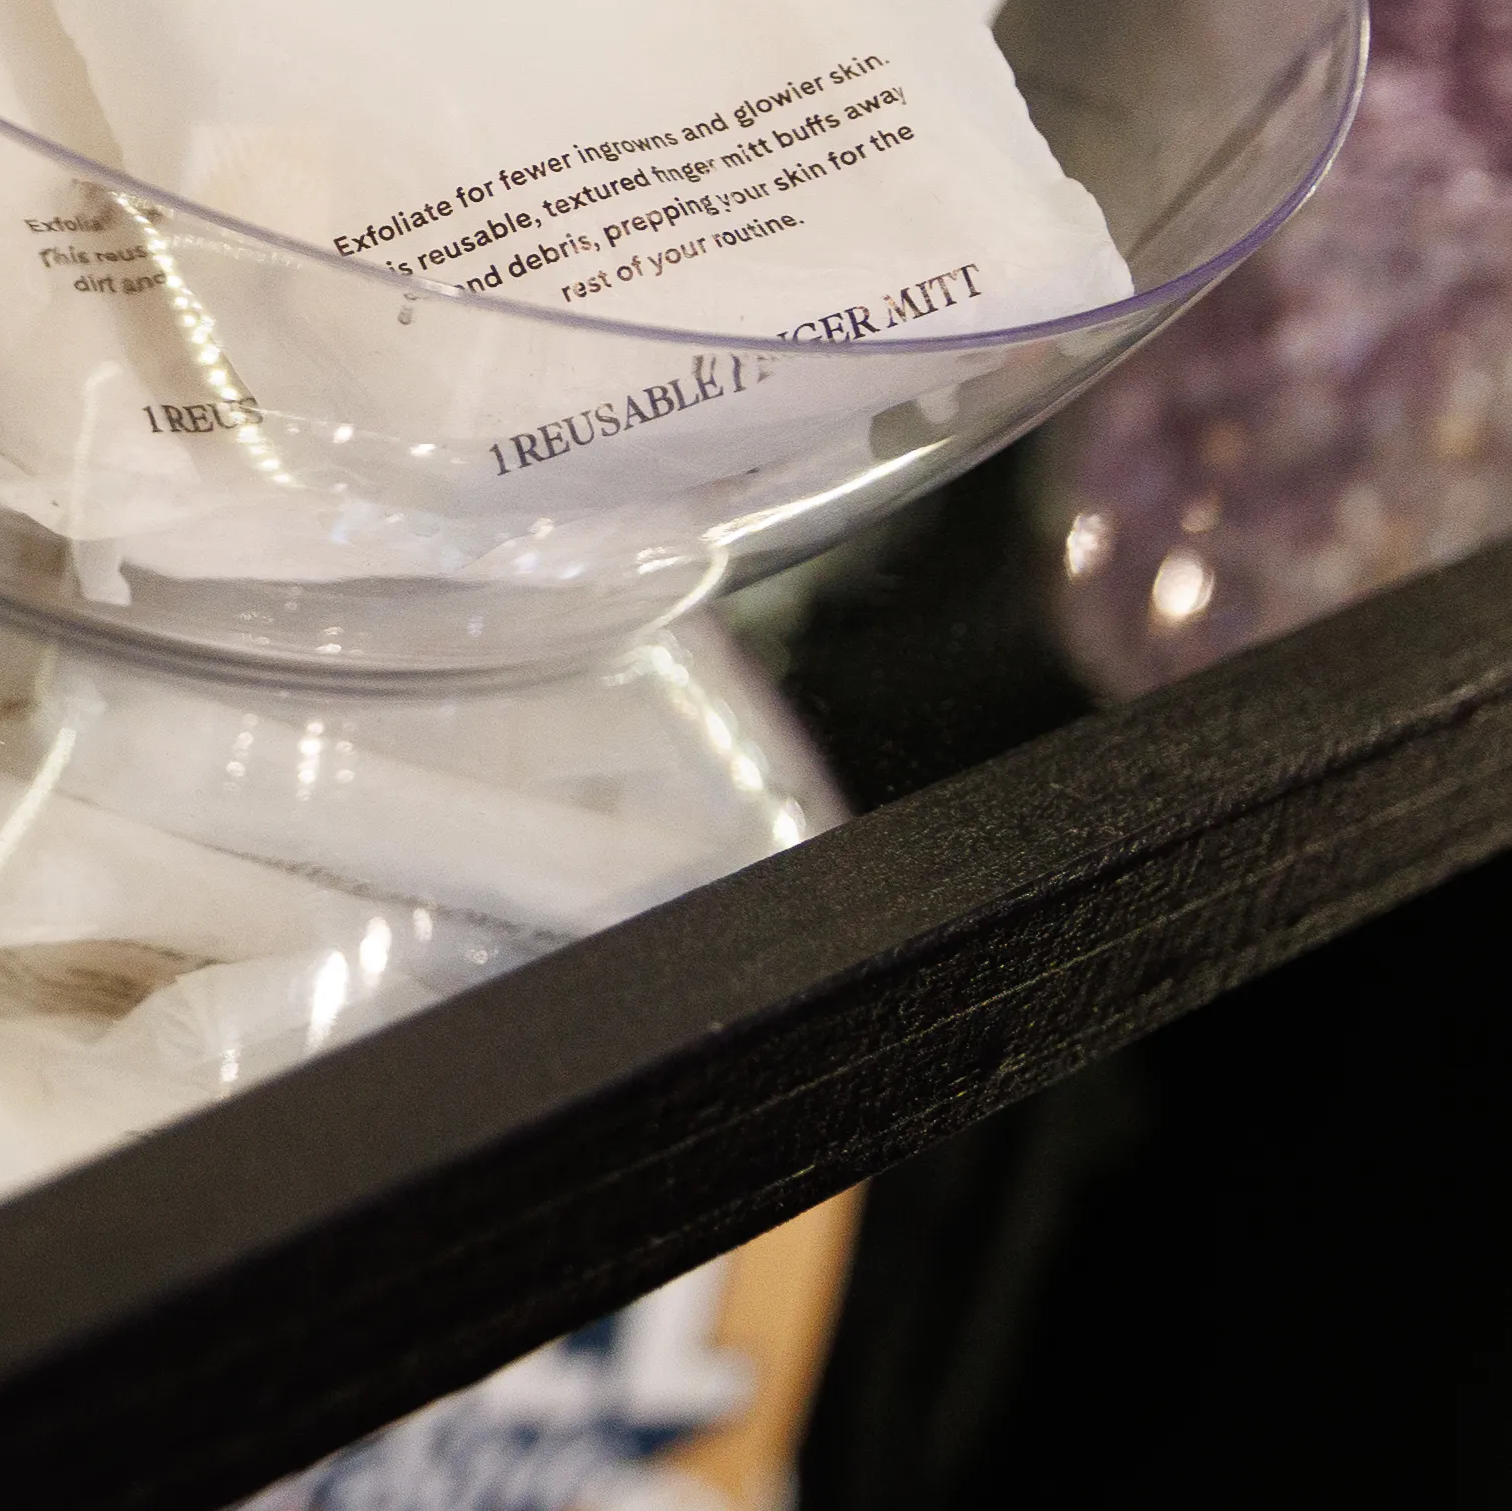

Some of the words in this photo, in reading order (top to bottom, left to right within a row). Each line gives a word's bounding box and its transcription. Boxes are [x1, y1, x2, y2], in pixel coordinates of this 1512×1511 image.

[333, 199, 454, 258] Exfoliate
[456, 179, 494, 208] for
[499, 152, 573, 191] fewer
[572, 132, 679, 163] ingrowns
[680, 112, 730, 142] and
[733, 76, 825, 129] glowier
[829, 55, 891, 85] skin.
[385, 260, 414, 276] is
[417, 211, 542, 271] reusable,
[541, 167, 652, 218] textured
[650, 156, 719, 184] finger
[720, 137, 774, 168] mitt
[771, 113, 842, 149] buffs
[843, 86, 908, 120] away
[507, 232, 601, 279] debris,
[602, 196, 721, 248] prepping
[714, 181, 771, 213] your
[773, 162, 828, 192] skin
[827, 143, 868, 171] for
[869, 124, 916, 152] the
[38, 245, 90, 268] This
[560, 269, 613, 303] rest
[616, 254, 644, 282] of
[645, 236, 708, 278] your
[711, 209, 806, 249] routine.
[142, 404, 164, 434] 1
[161, 397, 264, 434] REUS
[487, 442, 512, 477] 1
[509, 356, 725, 469] REUSABLE
[878, 263, 984, 328] MITT
